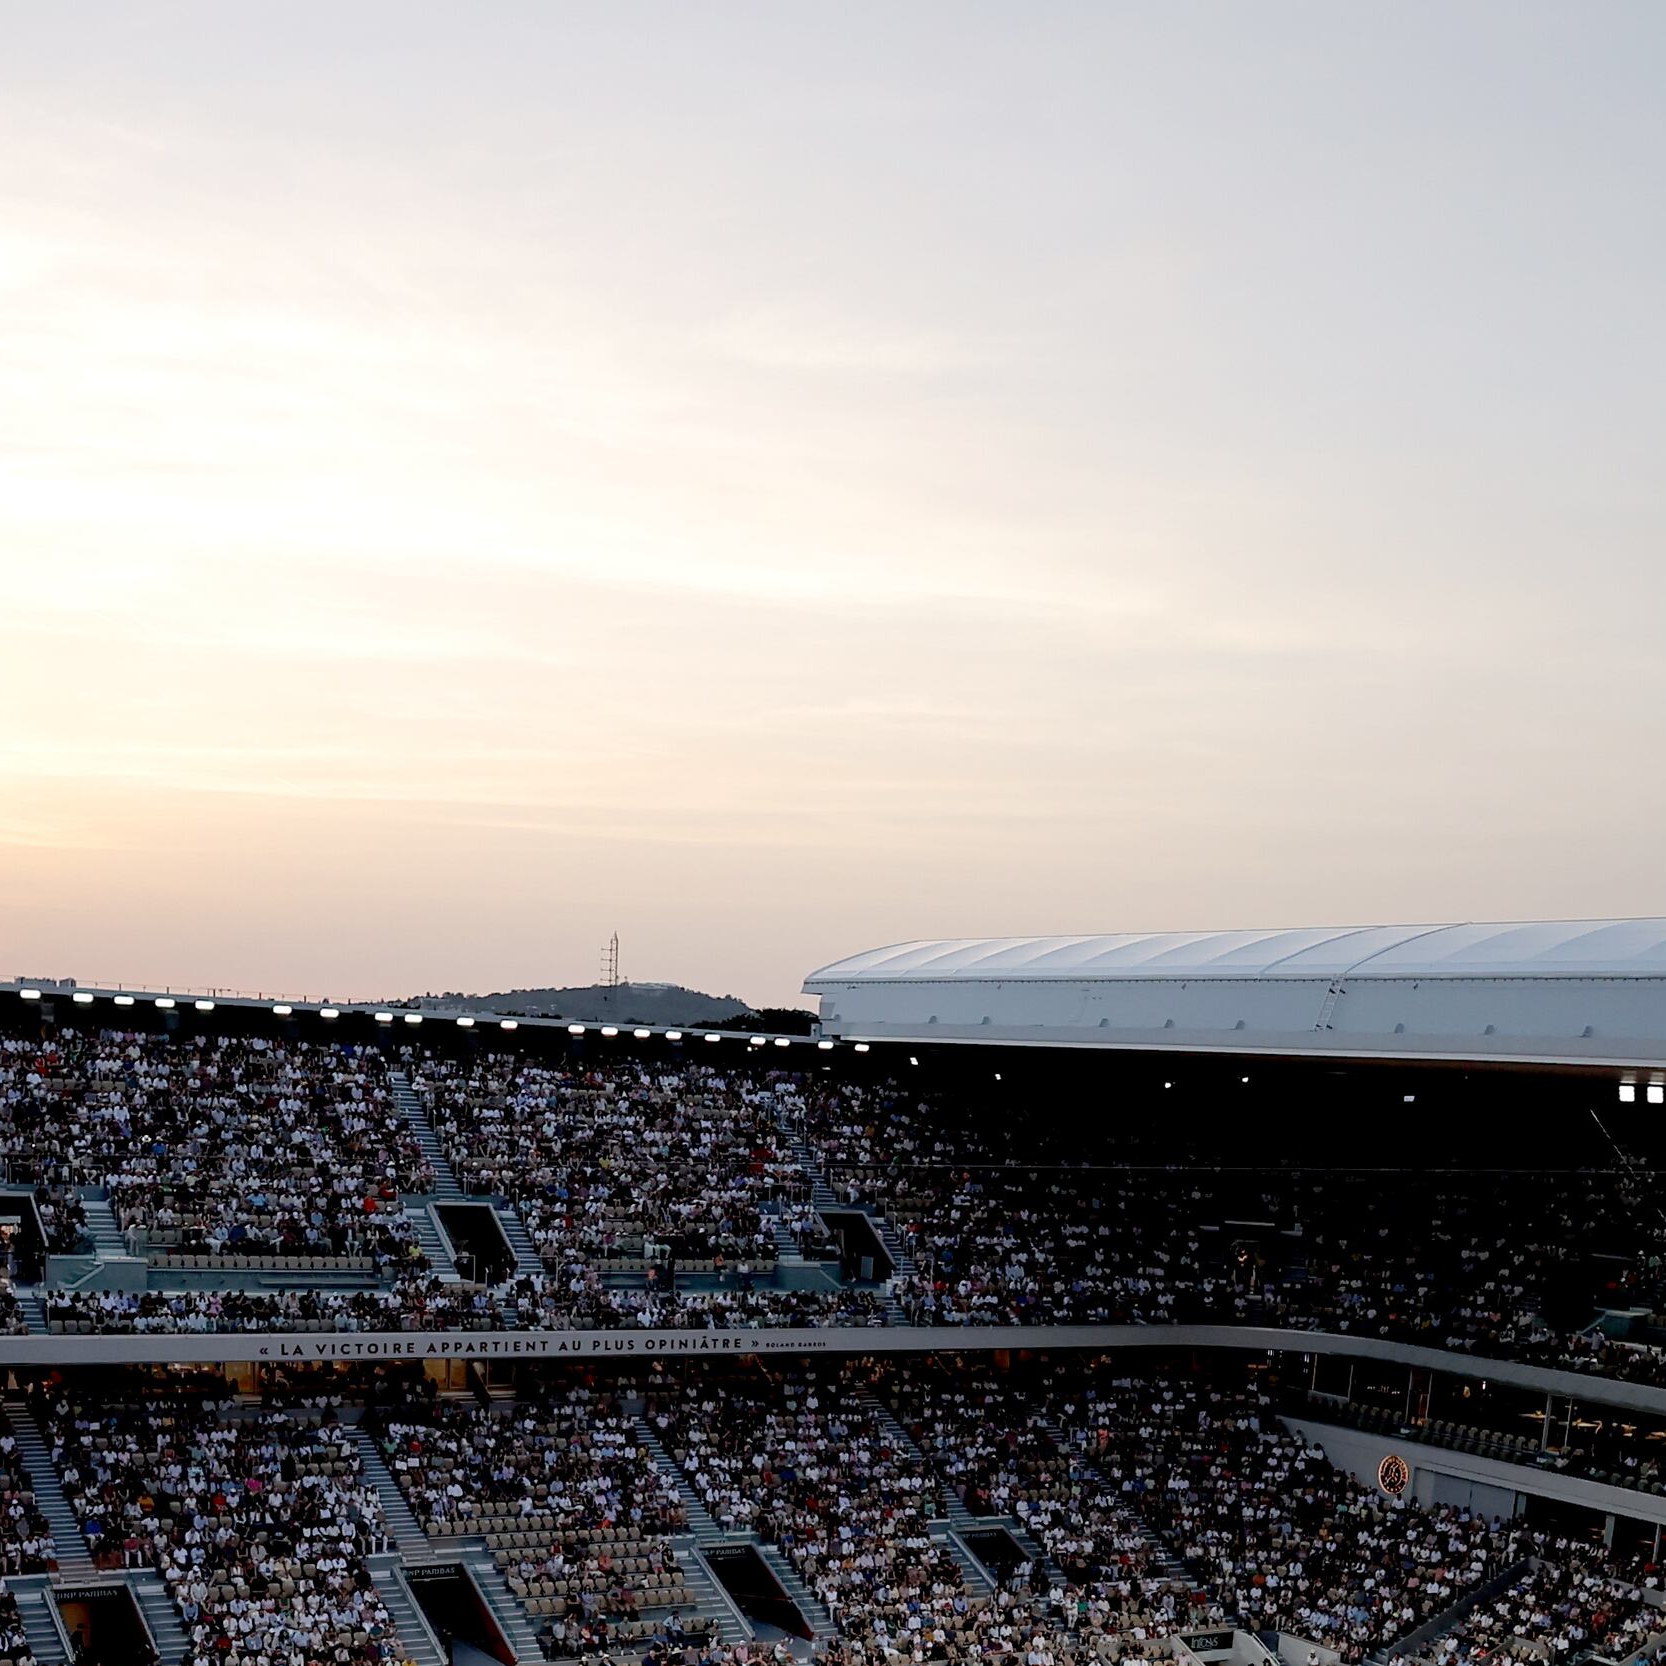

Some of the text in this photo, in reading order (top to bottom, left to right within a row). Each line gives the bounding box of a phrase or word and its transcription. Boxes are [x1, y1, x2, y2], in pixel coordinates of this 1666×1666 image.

[280, 1343, 304, 1356] LA
[315, 1342, 416, 1355] VICTOIRE
[427, 1340, 548, 1353] APPARTIENT
[559, 1340, 582, 1351] AU
[592, 1339, 635, 1351] PLUS
[645, 1336, 742, 1349] OPINIÂTRE
